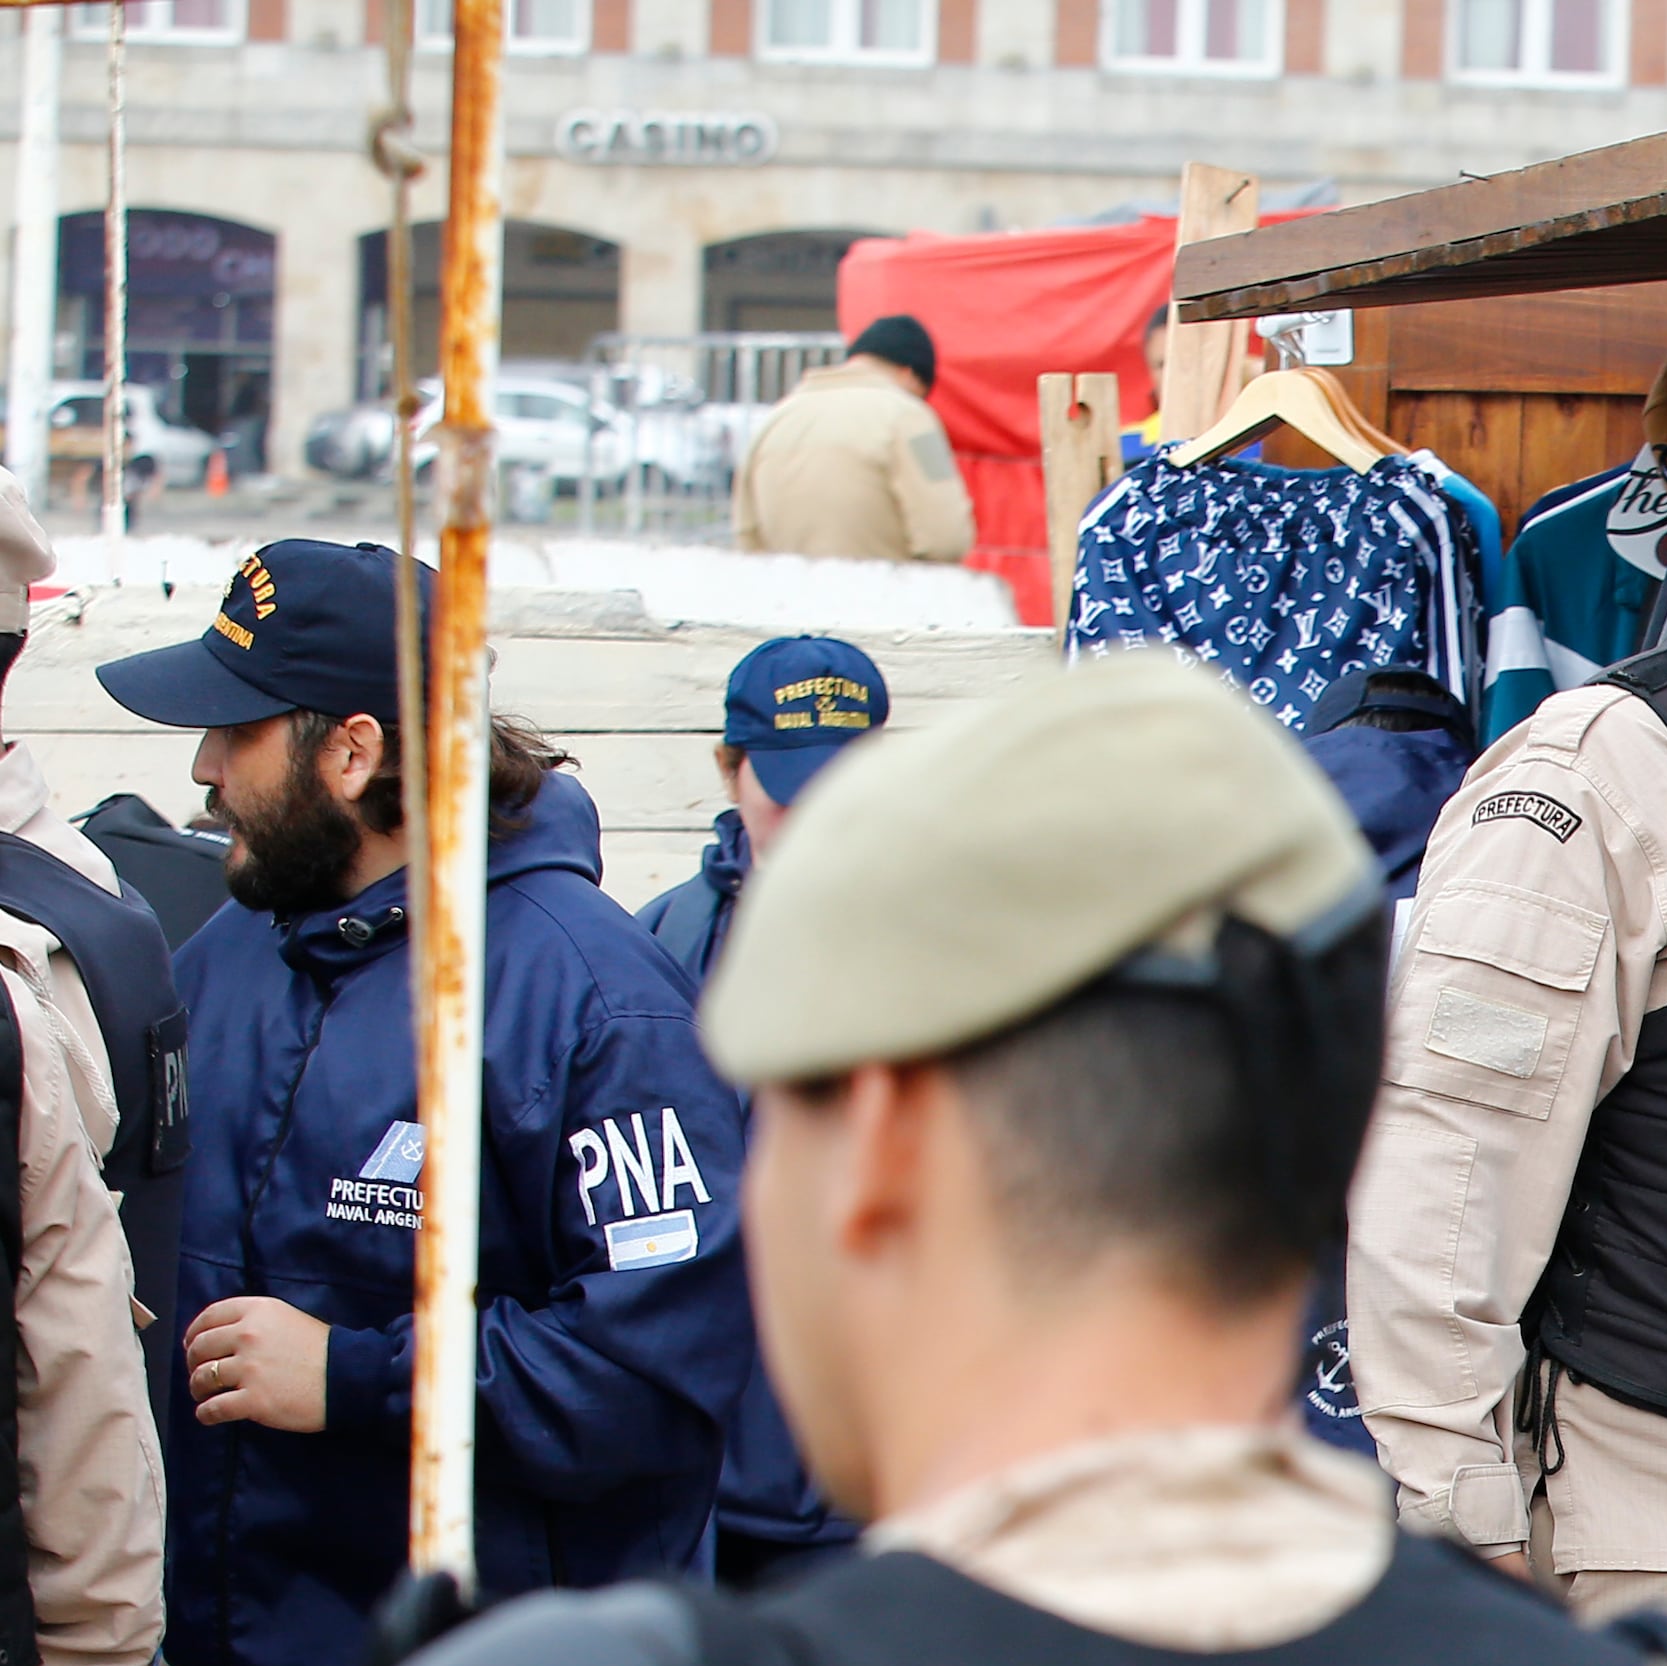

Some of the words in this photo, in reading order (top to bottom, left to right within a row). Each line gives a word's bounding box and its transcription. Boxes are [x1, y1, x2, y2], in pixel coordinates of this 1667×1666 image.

[565, 116, 767, 158] CASINO
[774, 676, 869, 705] PREFECTURA
[1477, 796, 1574, 837] PREFECTURA
[568, 1107, 713, 1227] PNA
[330, 1178, 424, 1211] PREFECTU
[326, 1202, 373, 1223] NAVAL
[1306, 1390, 1338, 1417] NAVAL
